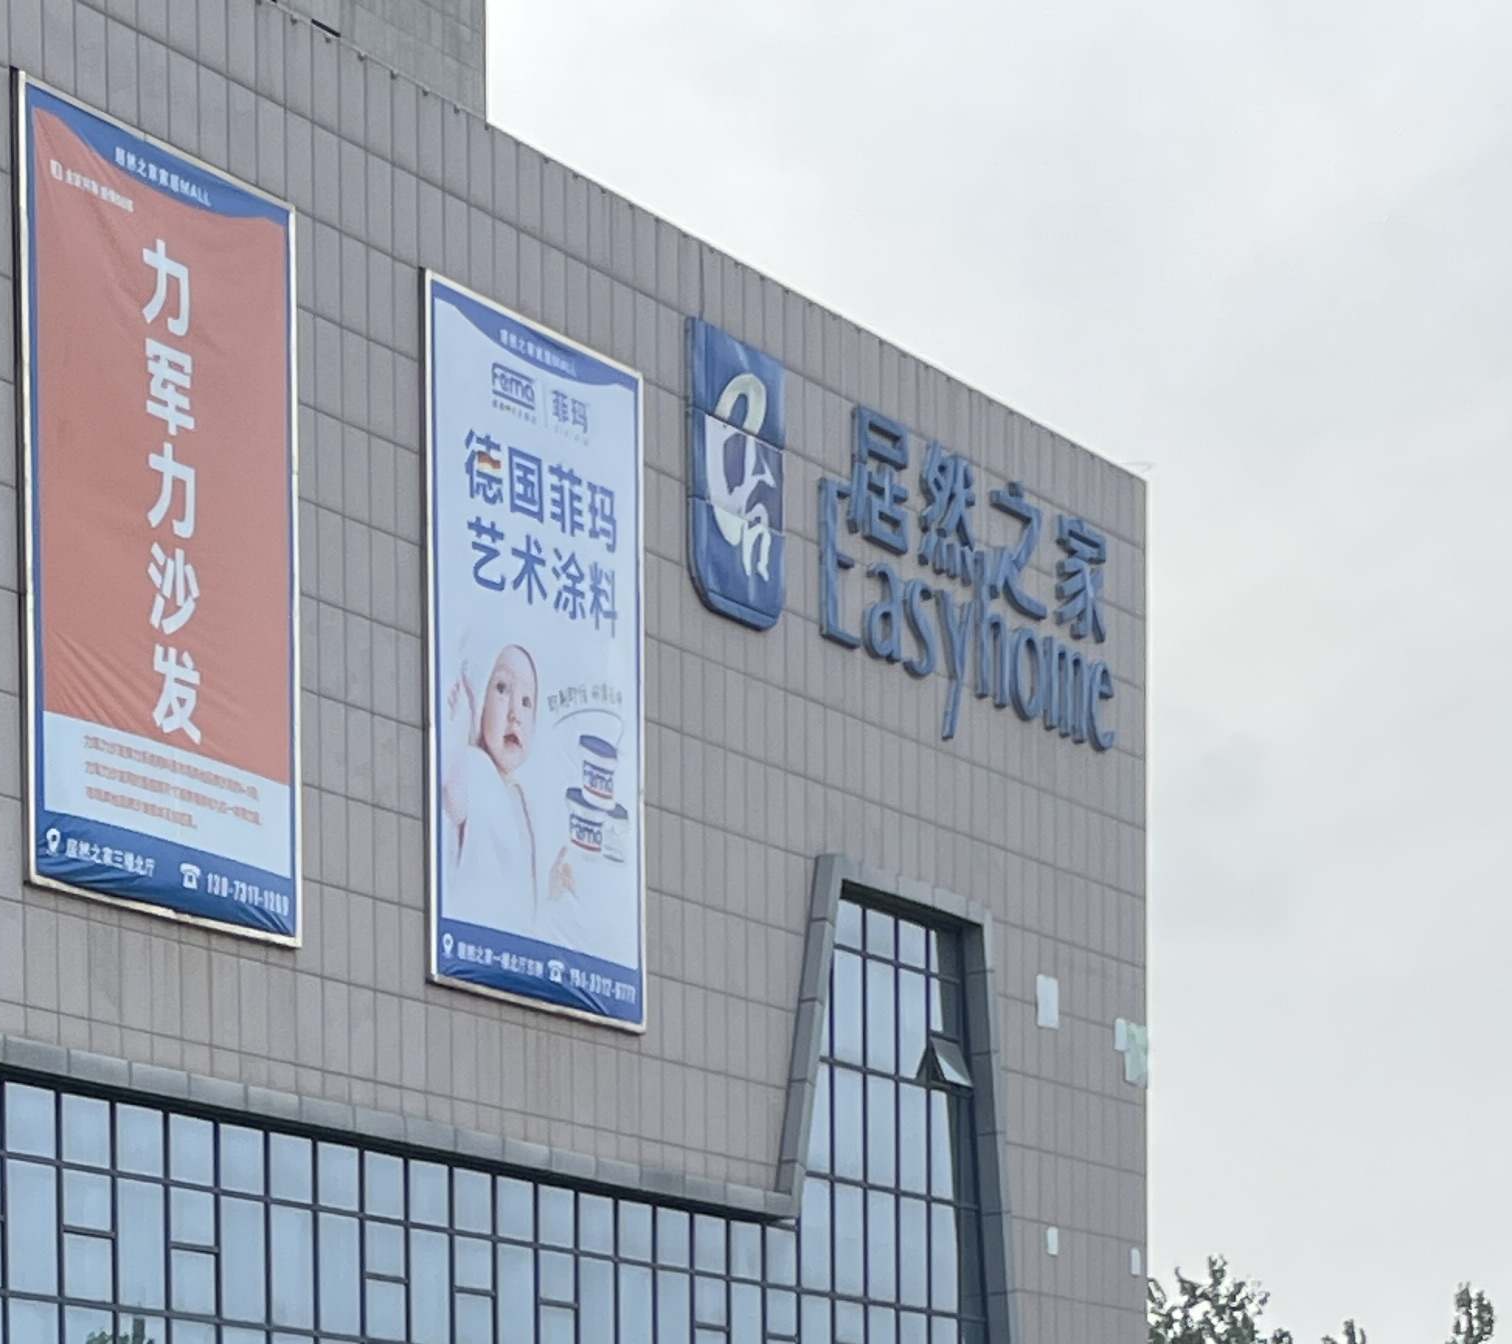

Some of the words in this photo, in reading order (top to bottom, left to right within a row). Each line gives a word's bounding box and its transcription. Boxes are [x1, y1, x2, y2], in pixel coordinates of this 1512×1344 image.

[142, 238, 201, 746] 力军力沙发
[464, 428, 618, 554] 德国菲玛
[466, 515, 618, 639] 艺术涂料
[846, 402, 1107, 645] 居然之家
